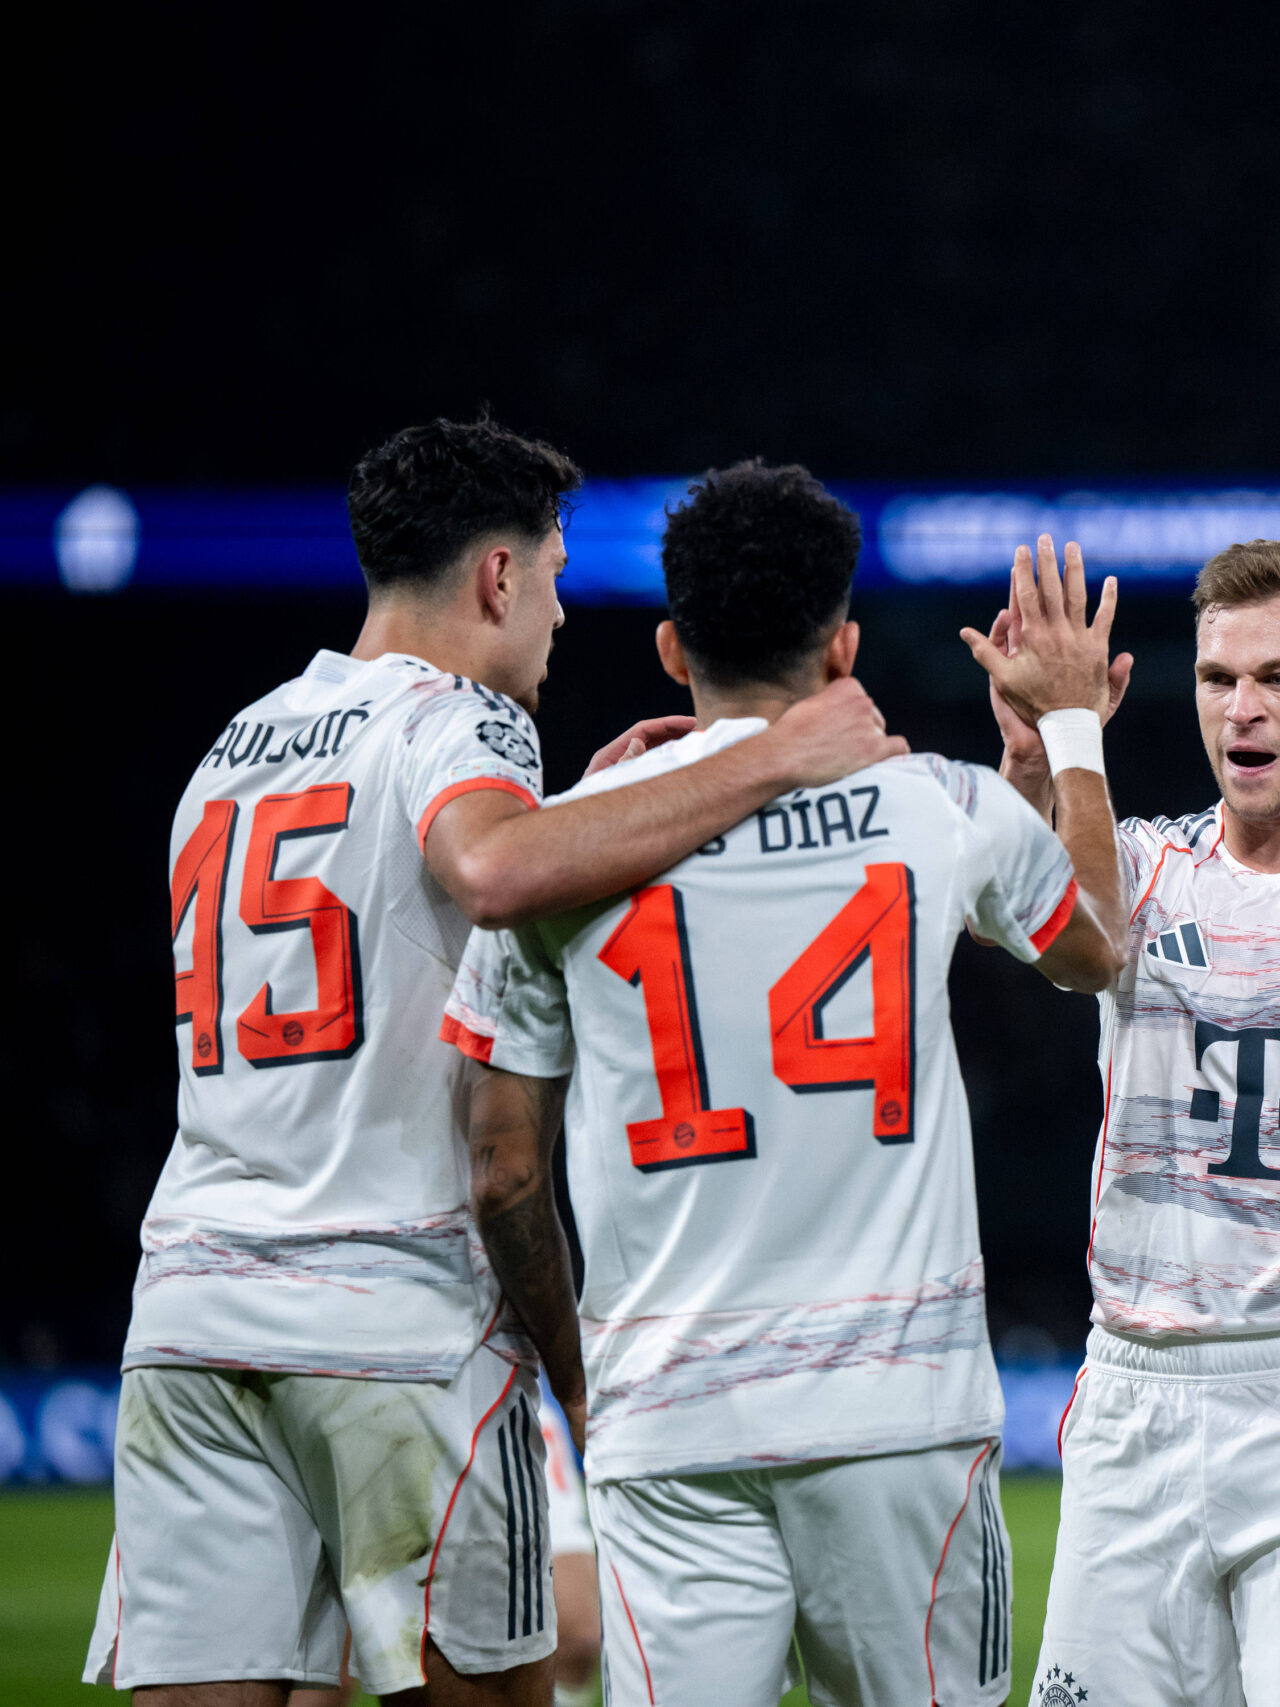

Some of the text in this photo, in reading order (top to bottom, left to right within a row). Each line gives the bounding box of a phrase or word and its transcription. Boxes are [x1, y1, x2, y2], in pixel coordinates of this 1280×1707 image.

[171, 781, 365, 1078] 45
[757, 786, 889, 854] DÍAZ
[596, 862, 917, 1174] 14
